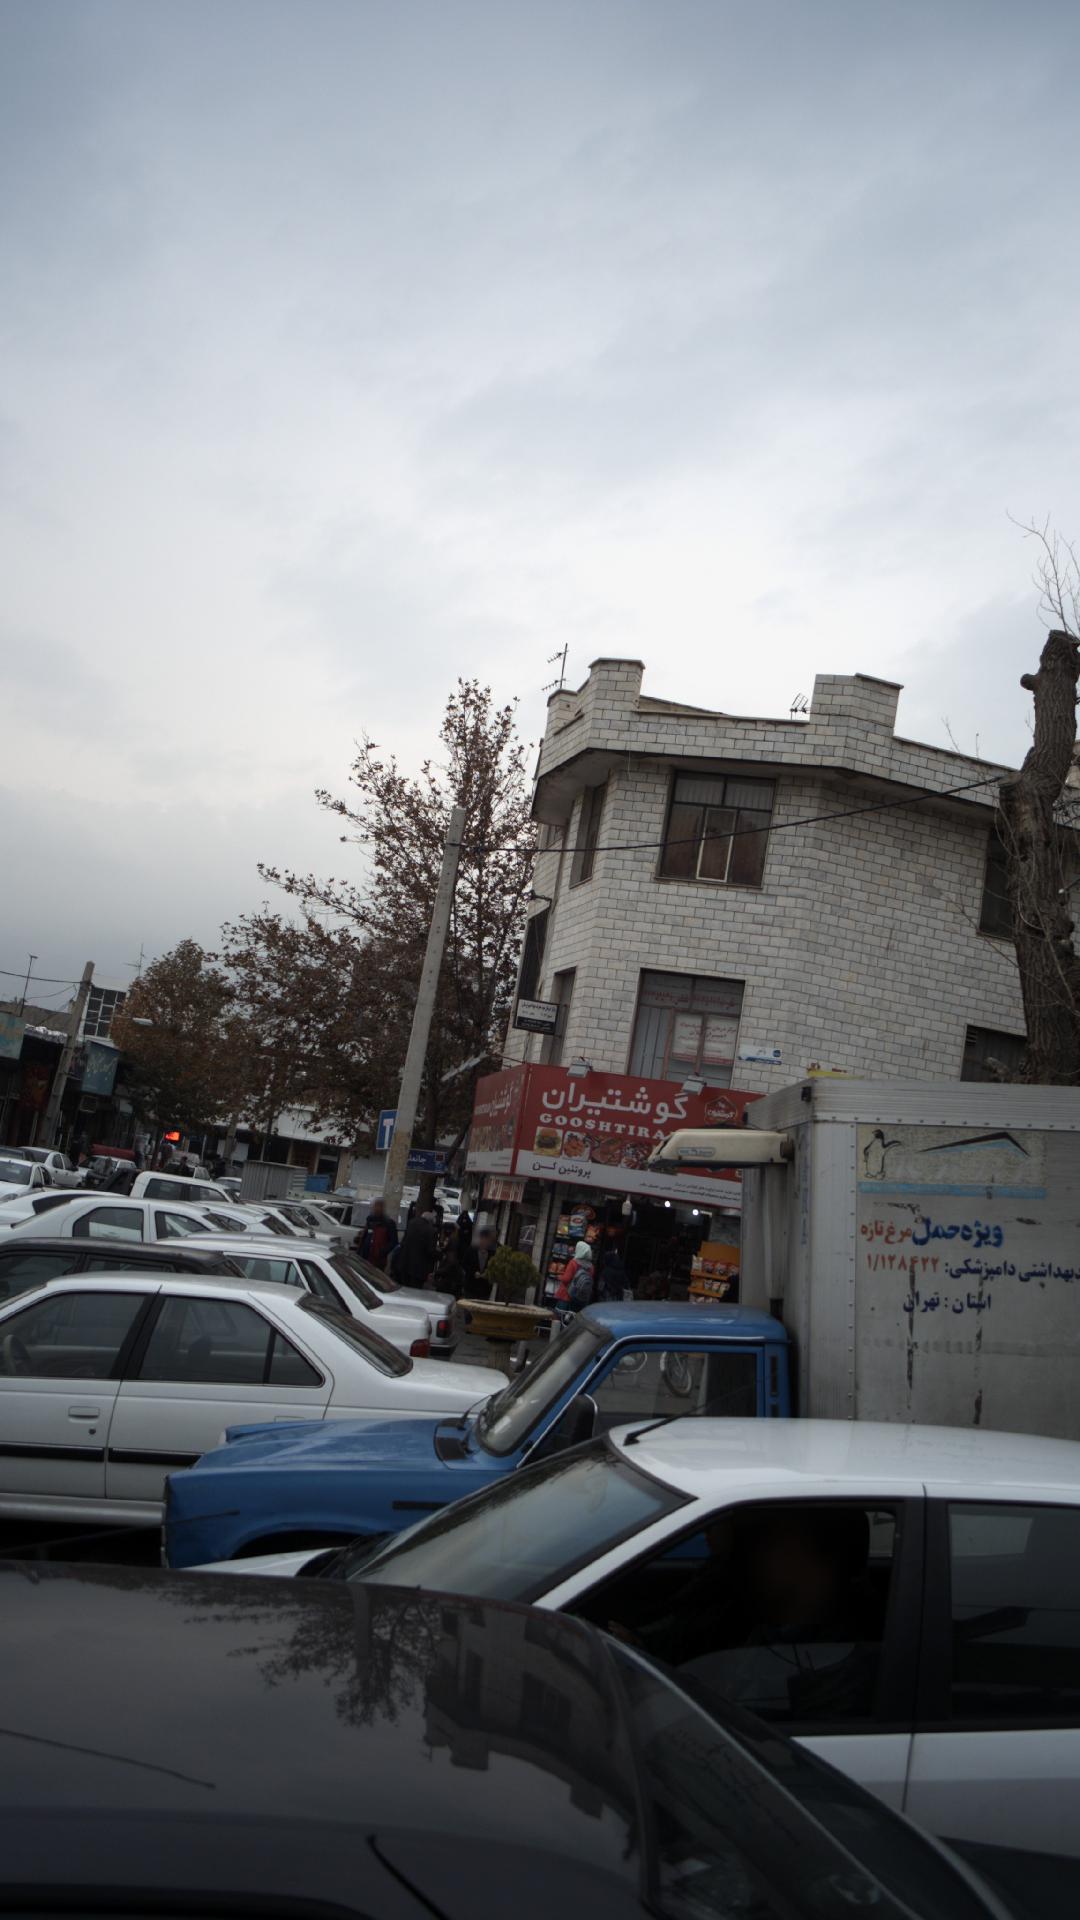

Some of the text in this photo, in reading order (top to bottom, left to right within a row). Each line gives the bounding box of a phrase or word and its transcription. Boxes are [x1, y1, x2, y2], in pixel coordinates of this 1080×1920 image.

[542, 1082, 689, 1124] گوشتیران
[539, 1112, 667, 1141] GOOSHTIRA
[860, 1216, 1004, 1248] ویژه حمل مرغ تازه
[903, 1290, 940, 1313] تهران
[952, 1293, 992, 1314] استان
